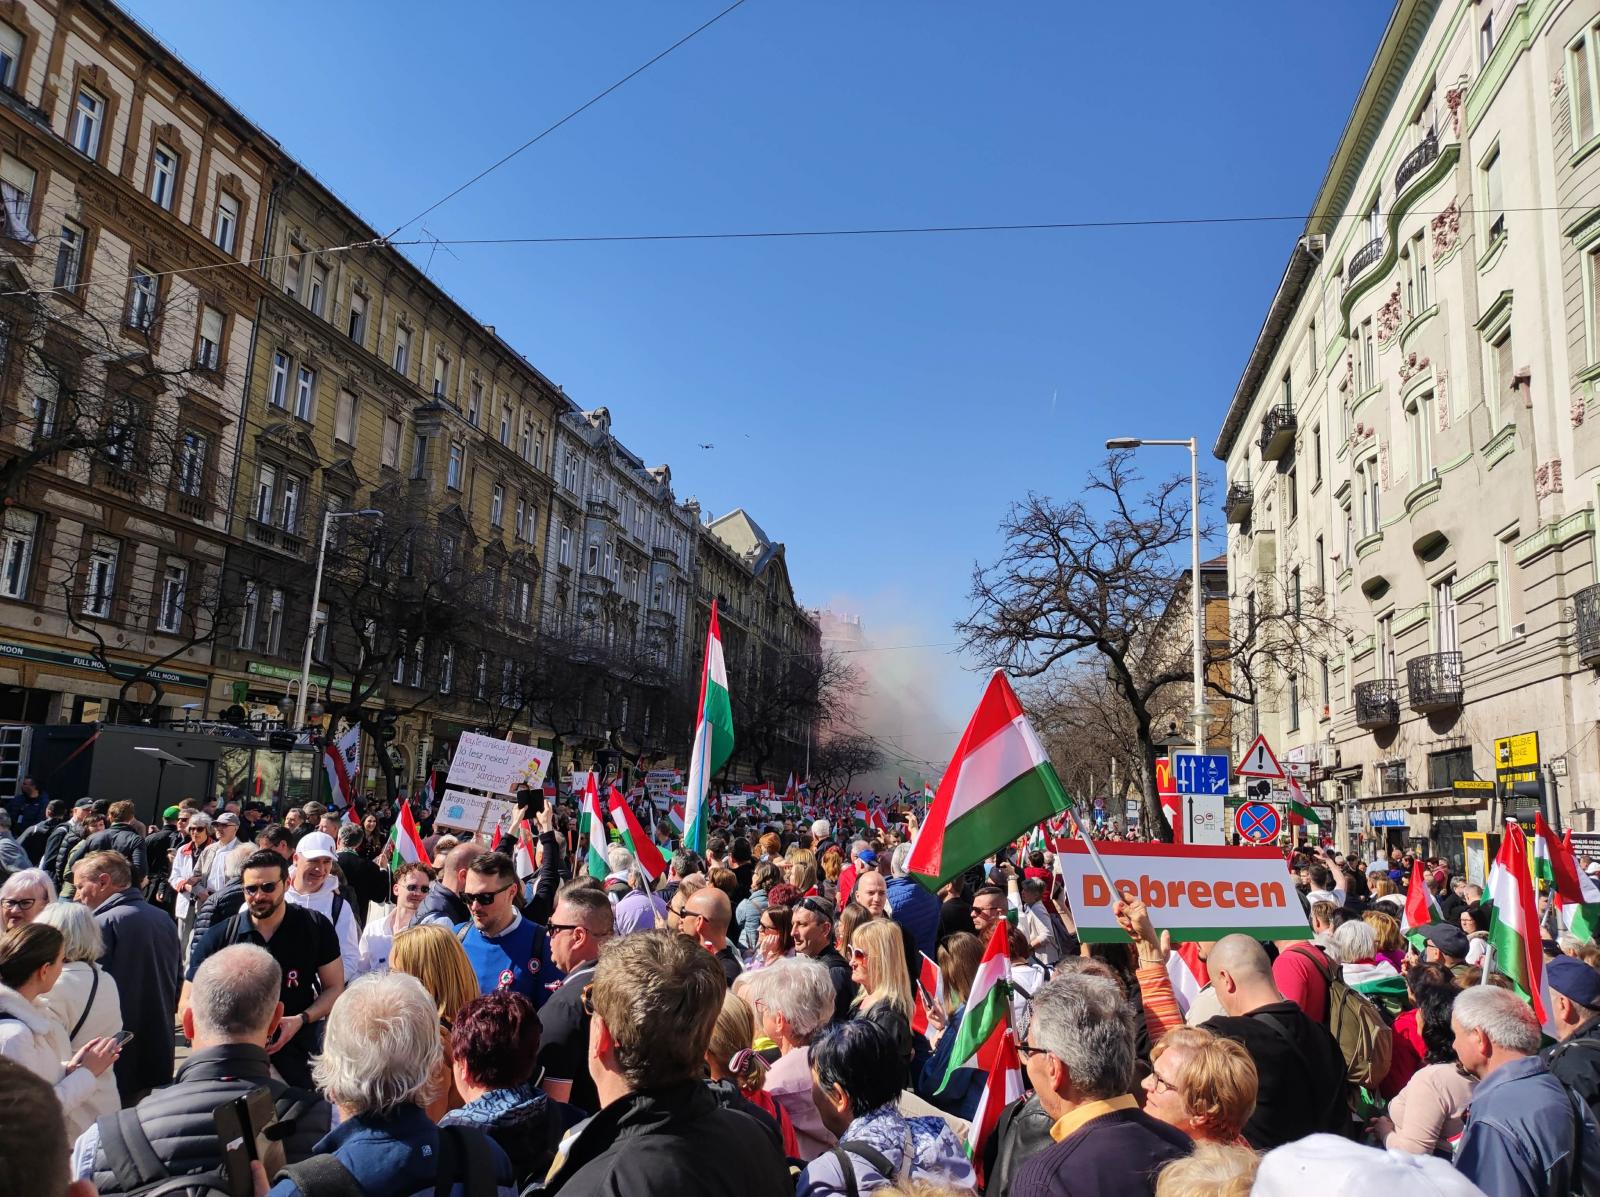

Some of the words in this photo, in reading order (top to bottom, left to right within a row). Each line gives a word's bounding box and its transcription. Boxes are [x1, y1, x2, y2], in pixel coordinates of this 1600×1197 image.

[0, 645, 24, 655] MOON
[73, 657, 89, 667] FULL
[146, 671, 161, 679] FULL
[162, 672, 180, 682] MOON
[1082, 873, 1287, 909] Debrecen
